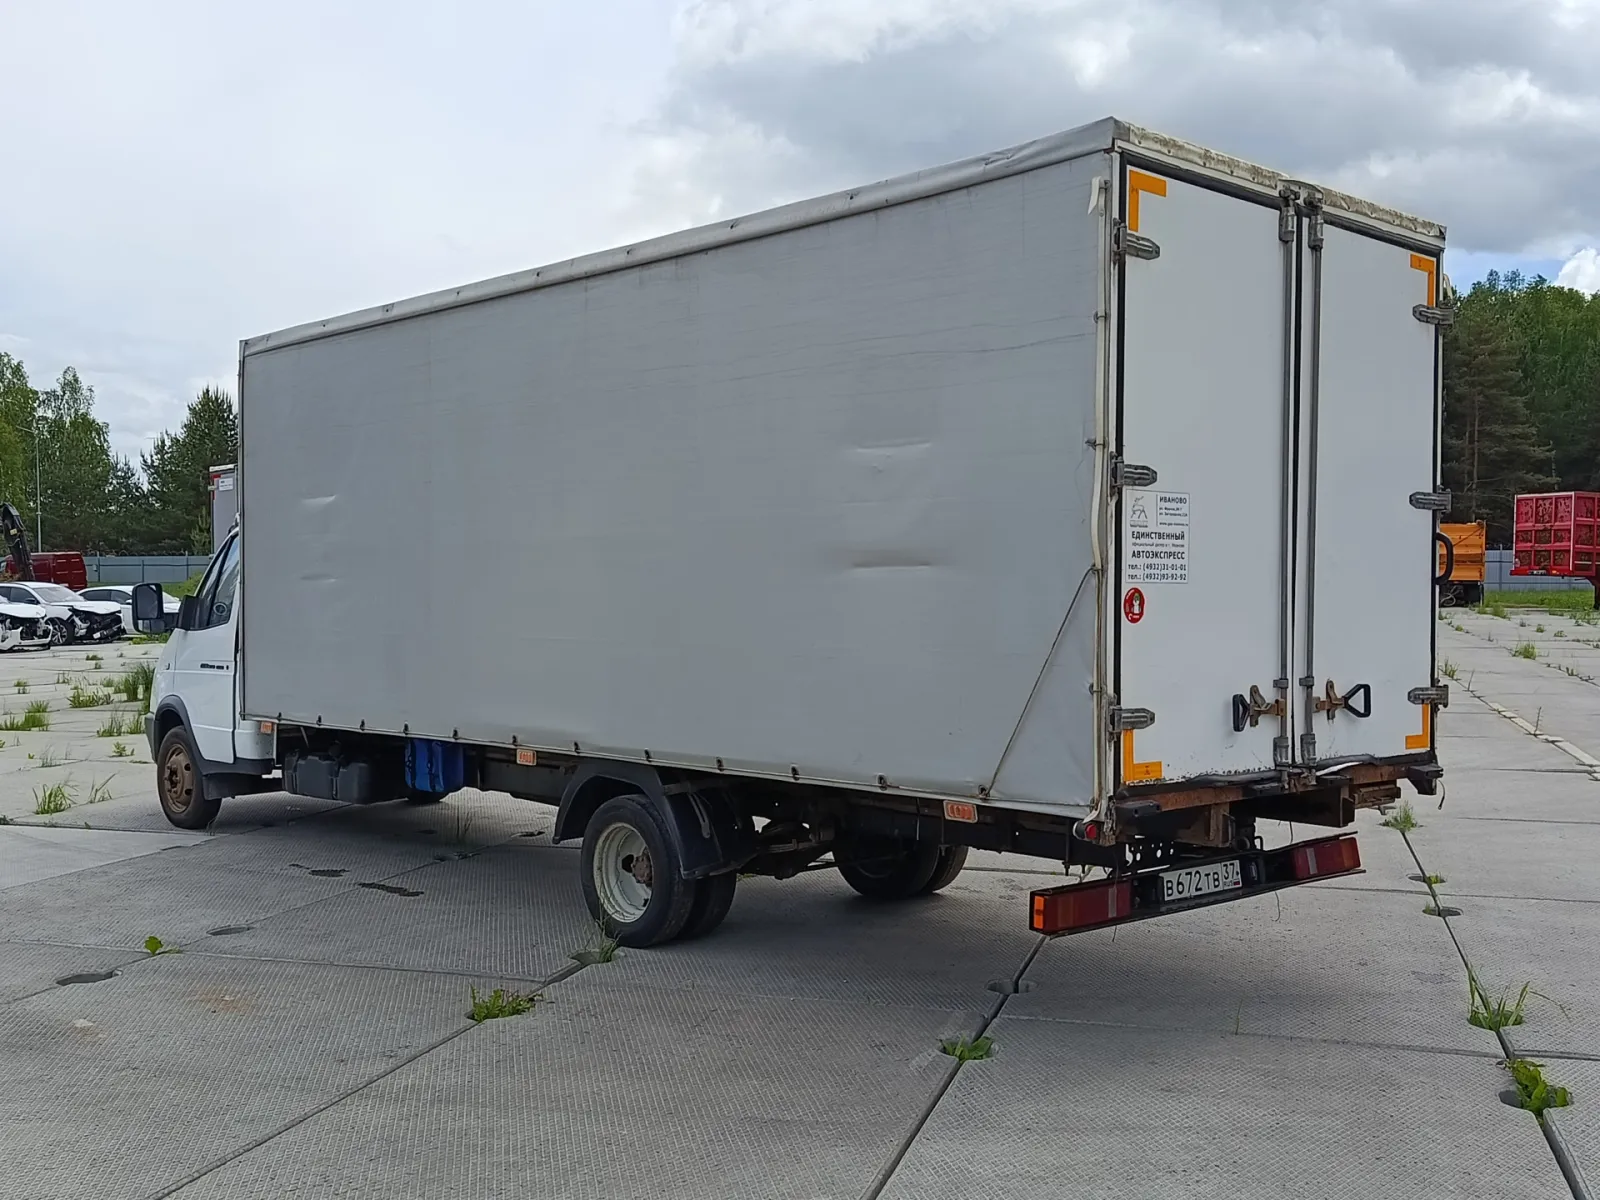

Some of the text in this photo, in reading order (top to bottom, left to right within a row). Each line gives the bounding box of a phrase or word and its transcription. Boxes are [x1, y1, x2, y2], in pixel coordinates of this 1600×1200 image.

[1159, 496, 1187, 504] ИВАНОВО
[1131, 531, 1185, 541] ЕДИНСТВЕННЫЙ
[1131, 550, 1185, 560] АВТОЭКСПРЕСС
[1142, 562, 1187, 571] (4932)31-01-01
[1142, 572, 1187, 581] (4932)93-92-92
[1222, 862, 1235, 880] 37
